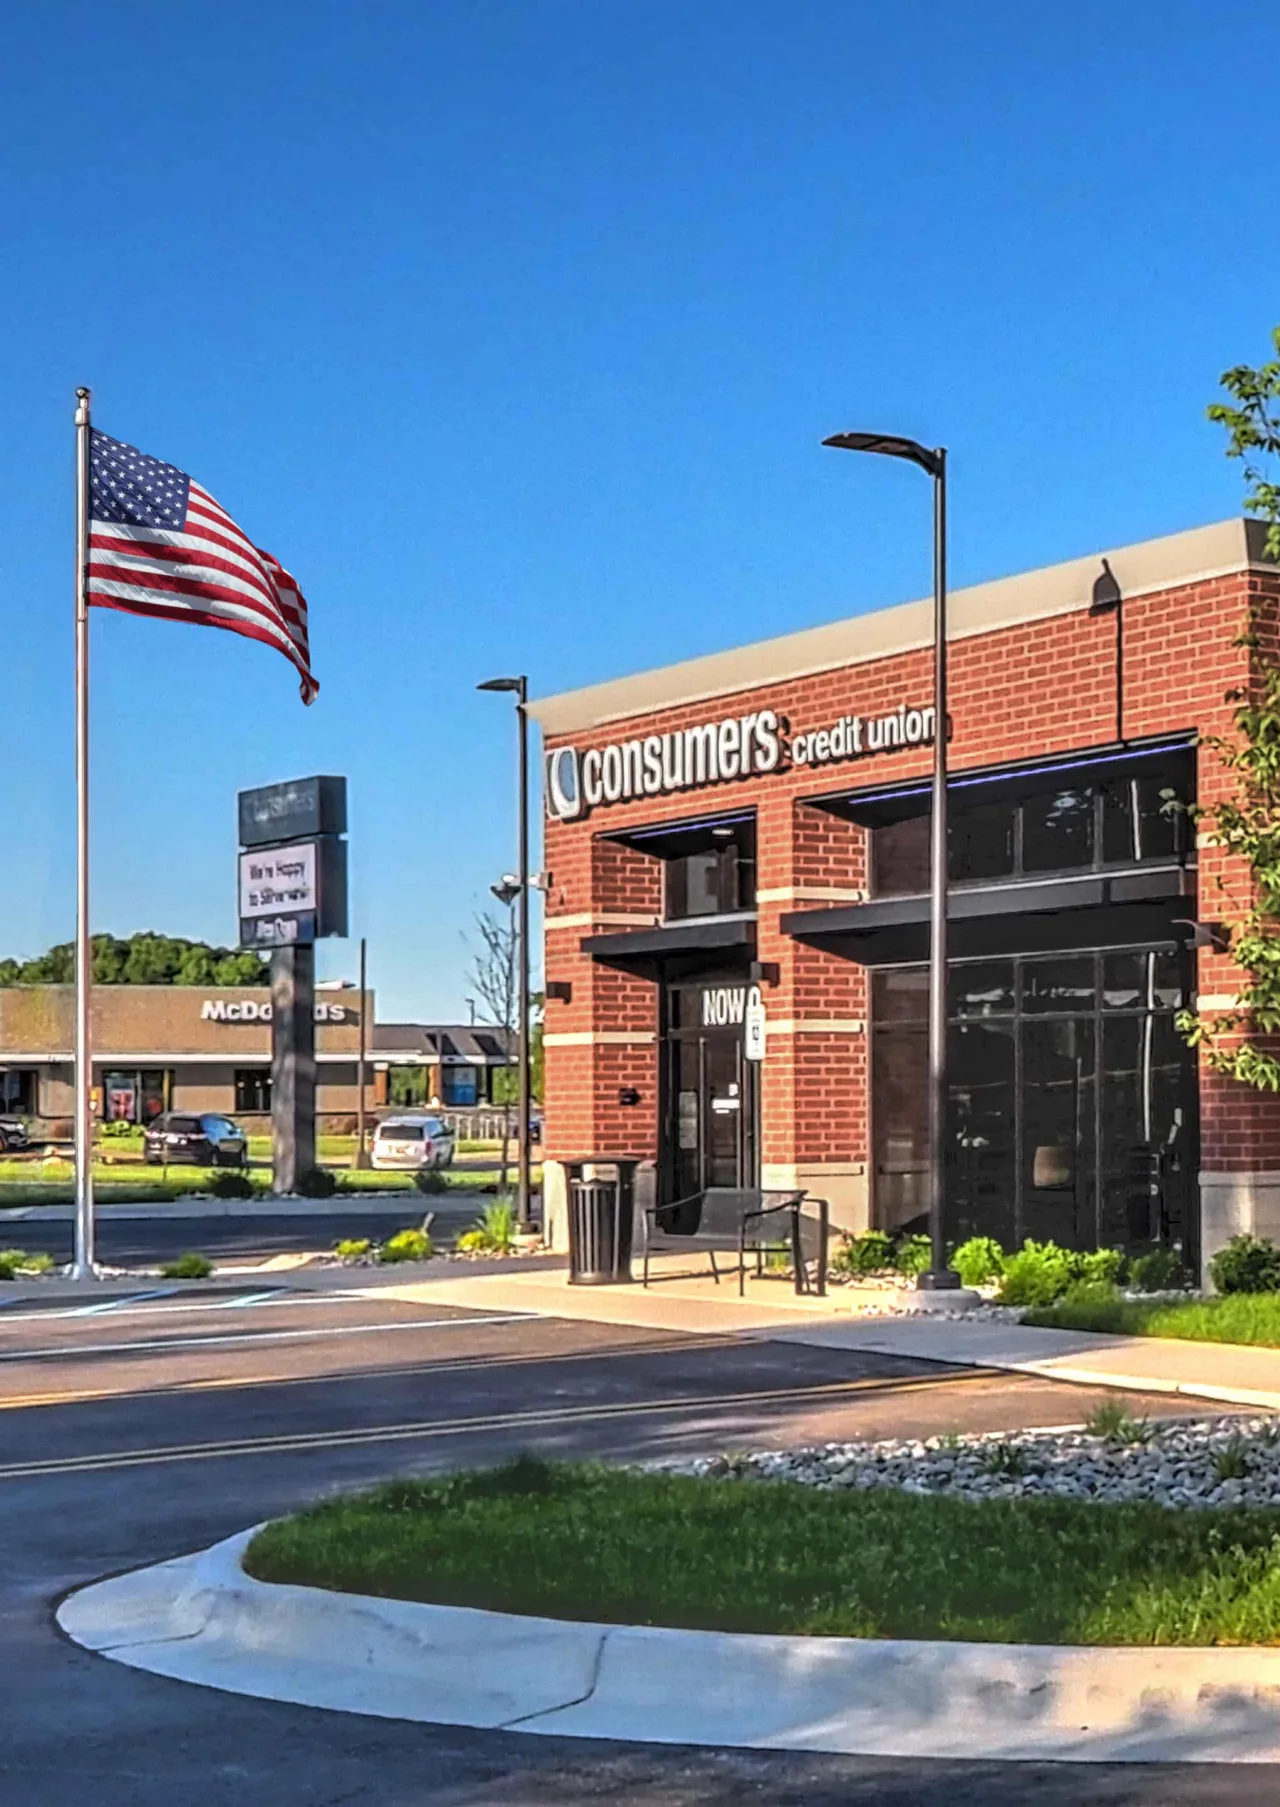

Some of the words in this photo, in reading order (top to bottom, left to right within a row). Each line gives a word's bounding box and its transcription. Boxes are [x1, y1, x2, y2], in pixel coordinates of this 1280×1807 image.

[583, 709, 778, 804] consumers
[792, 716, 862, 764] credit
[868, 705, 936, 749] union
[703, 987, 746, 1026] NOW
